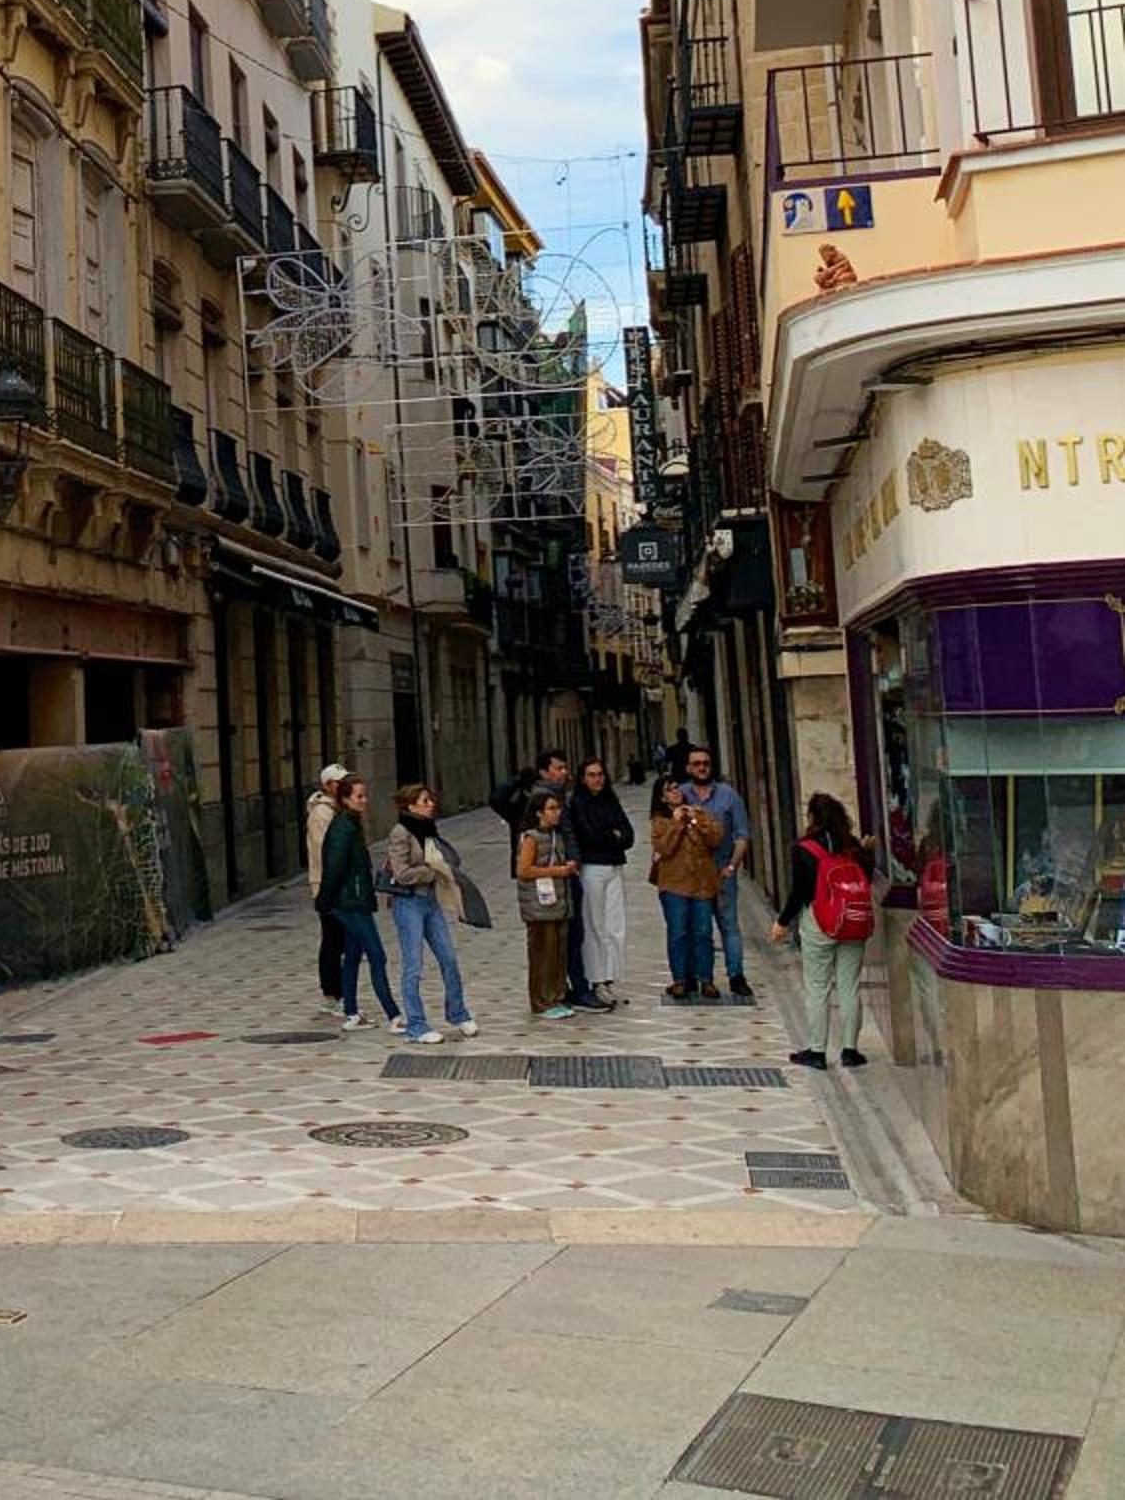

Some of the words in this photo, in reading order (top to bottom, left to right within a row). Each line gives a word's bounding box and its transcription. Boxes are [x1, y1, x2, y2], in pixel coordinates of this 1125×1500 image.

[627, 329, 656, 499] RESTAURANTE
[12, 835, 28, 854] DE
[10, 854, 65, 877] HISTORIA
